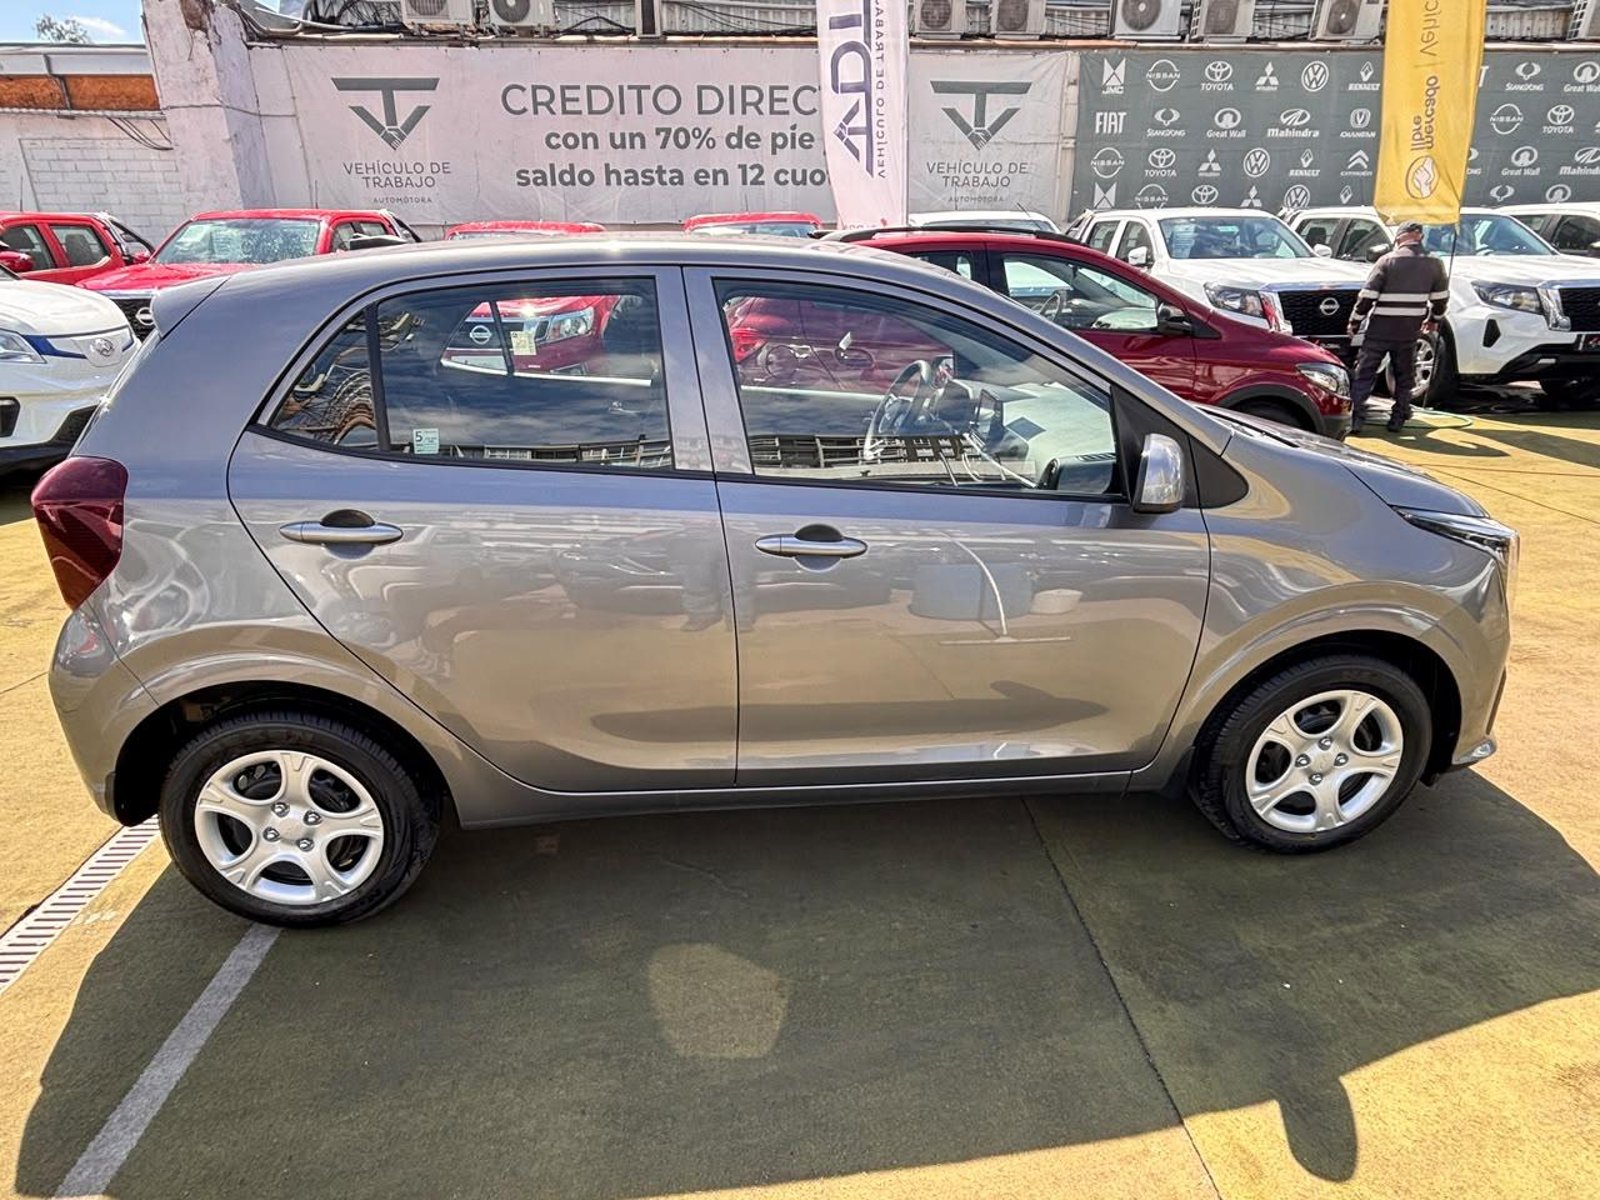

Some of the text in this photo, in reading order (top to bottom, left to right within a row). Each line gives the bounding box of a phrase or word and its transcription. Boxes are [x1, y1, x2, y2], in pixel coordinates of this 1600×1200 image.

[1201, 83, 1234, 91] TOYOTA
[501, 84, 821, 116] CREDITO DIREC
[1095, 112, 1127, 134] FIAT
[1206, 129, 1246, 138] Great Wall
[1267, 128, 1320, 138] Mahindra
[1542, 126, 1574, 134] TOYOTA
[545, 131, 600, 150] con
[610, 131, 647, 150] un
[656, 127, 717, 150] 70%
[725, 125, 762, 150] de
[343, 160, 451, 175] VEHÍCULO DE
[926, 159, 1029, 175] VEHÍCULO DE
[1144, 169, 1177, 177] TOYOTA
[1501, 168, 1521, 176] Great
[1560, 166, 1600, 175] Mahind
[516, 163, 831, 187] saldo hasta en 12 cuo
[362, 176, 436, 188] TRABAJO
[942, 176, 1011, 188] TRABAJO
[373, 196, 432, 204] AUTOMOTORA
[415, 430, 423, 442] 5
